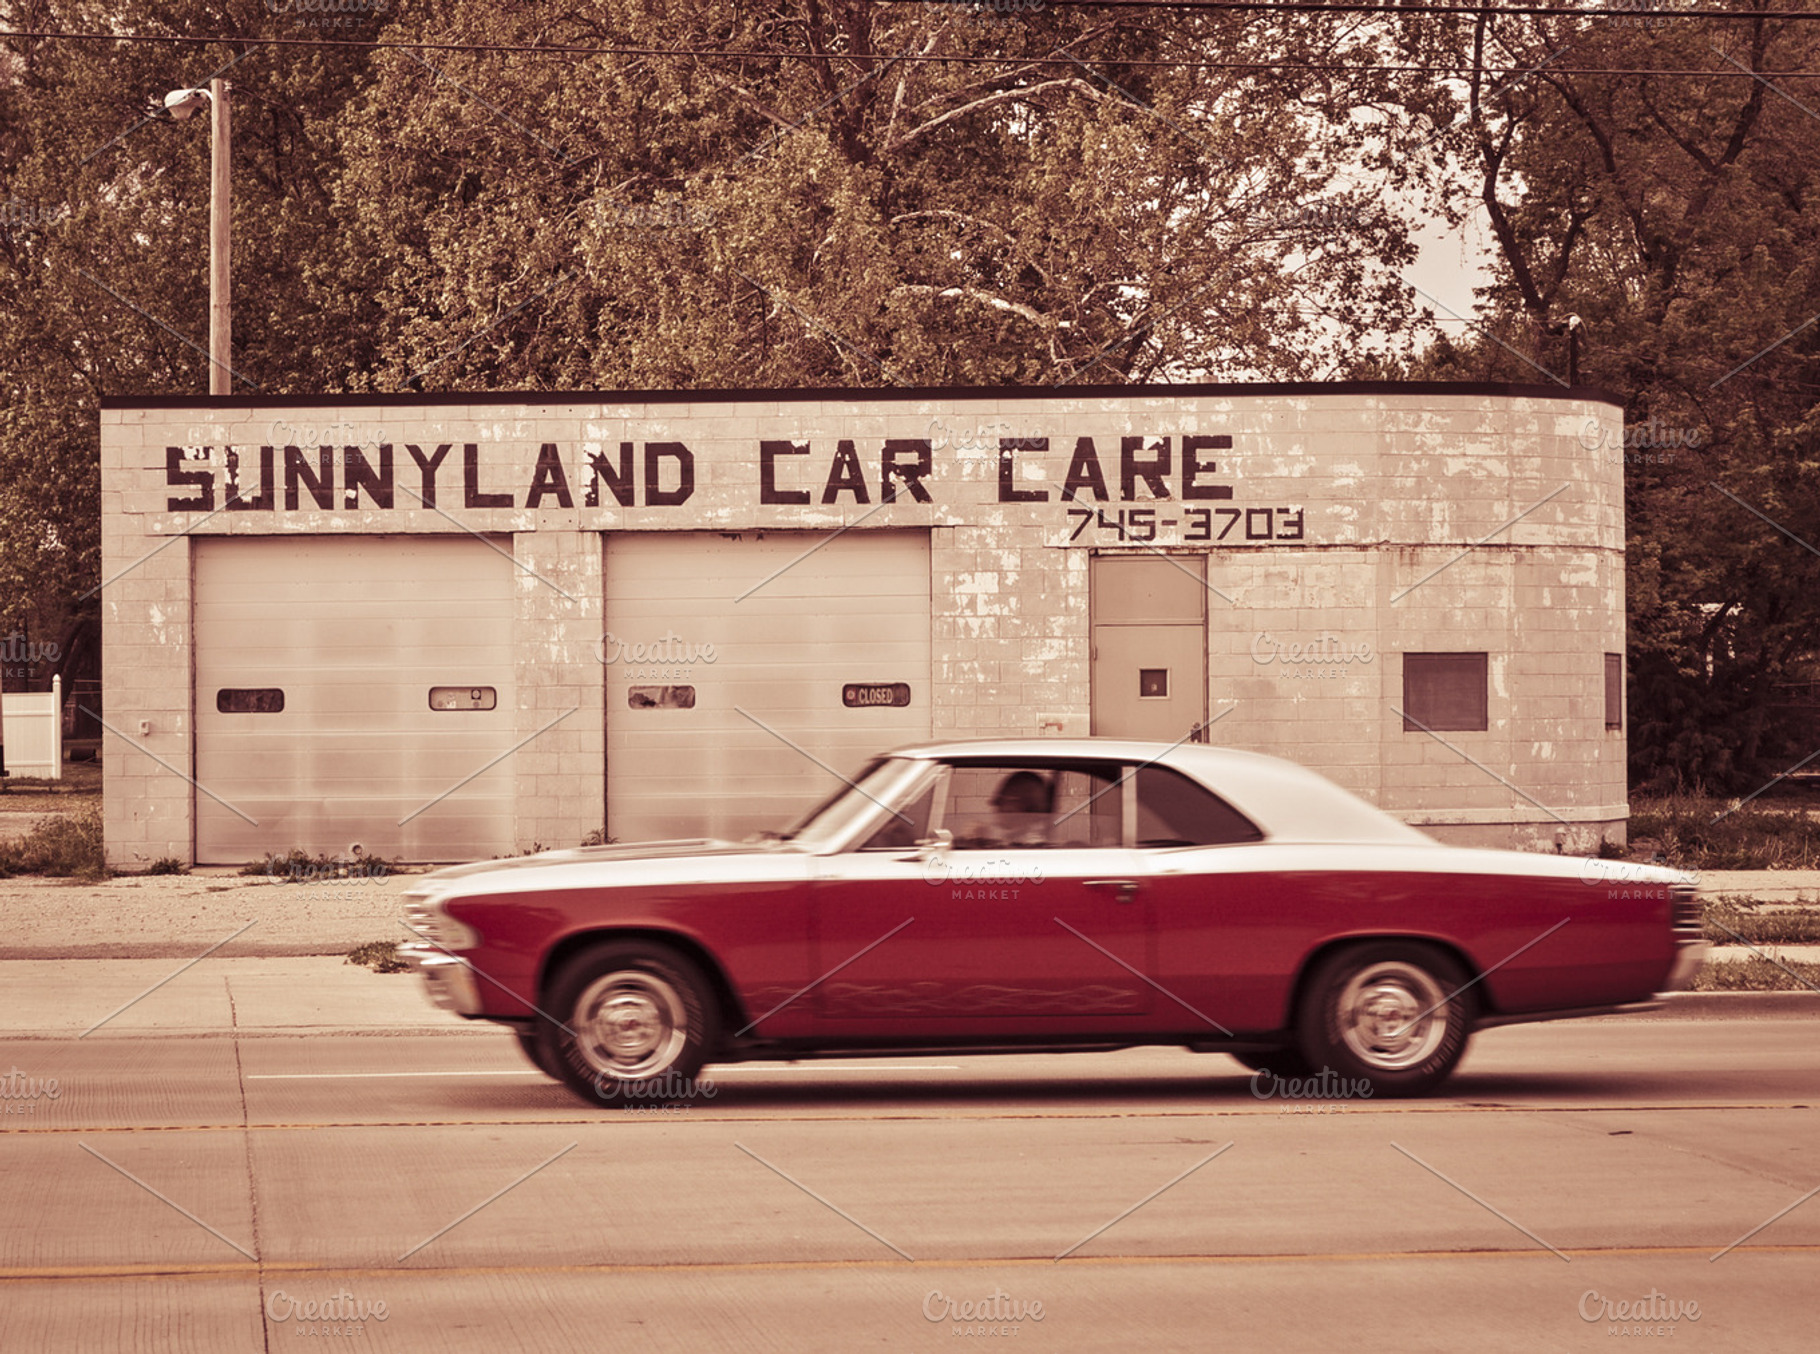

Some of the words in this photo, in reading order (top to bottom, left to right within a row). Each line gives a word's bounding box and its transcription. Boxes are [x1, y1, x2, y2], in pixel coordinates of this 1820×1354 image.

[166, 441, 695, 512] SUNNYLAND
[760, 438, 932, 505] CAR
[998, 435, 1233, 502] CARE
[1067, 508, 1304, 541] 745-3703
[859, 687, 893, 704] CLOSED
